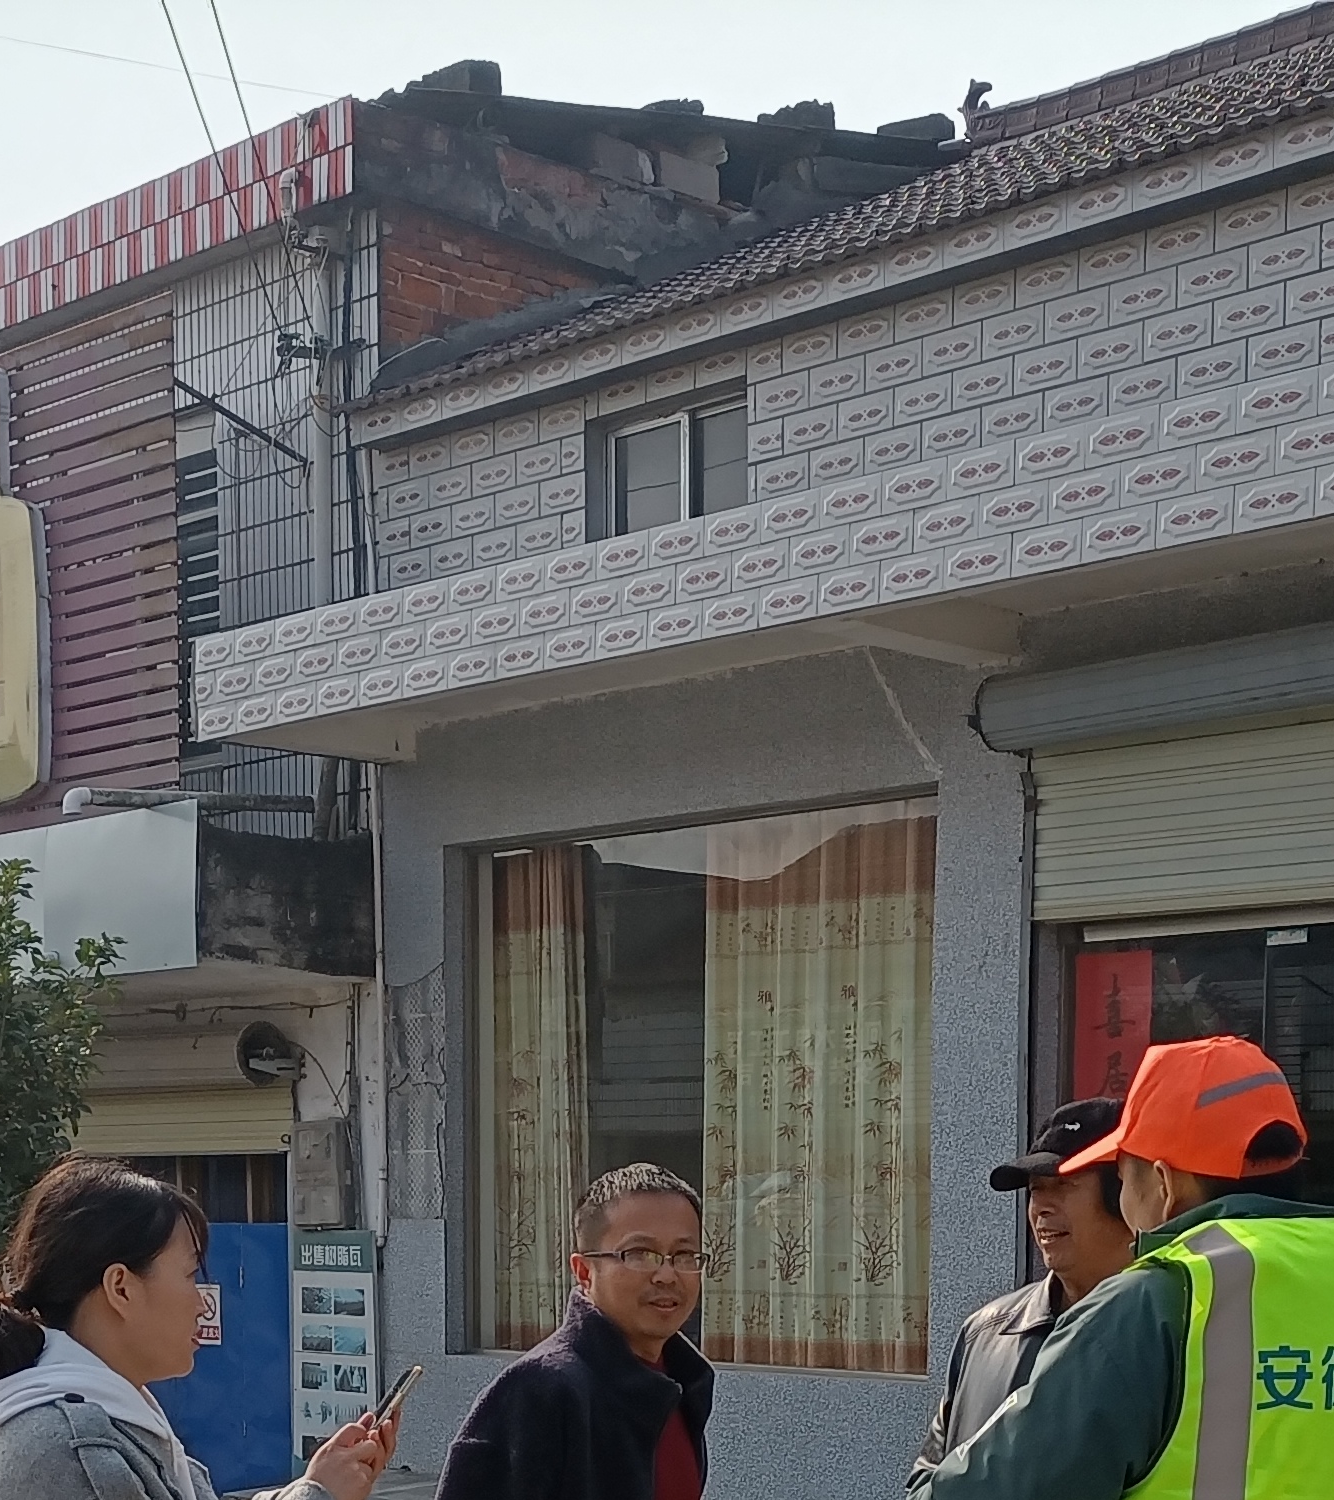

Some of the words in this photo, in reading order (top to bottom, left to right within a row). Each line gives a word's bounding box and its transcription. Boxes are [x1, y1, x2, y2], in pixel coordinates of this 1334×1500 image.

[301, 1243, 362, 1267] 出售树脂瓦
